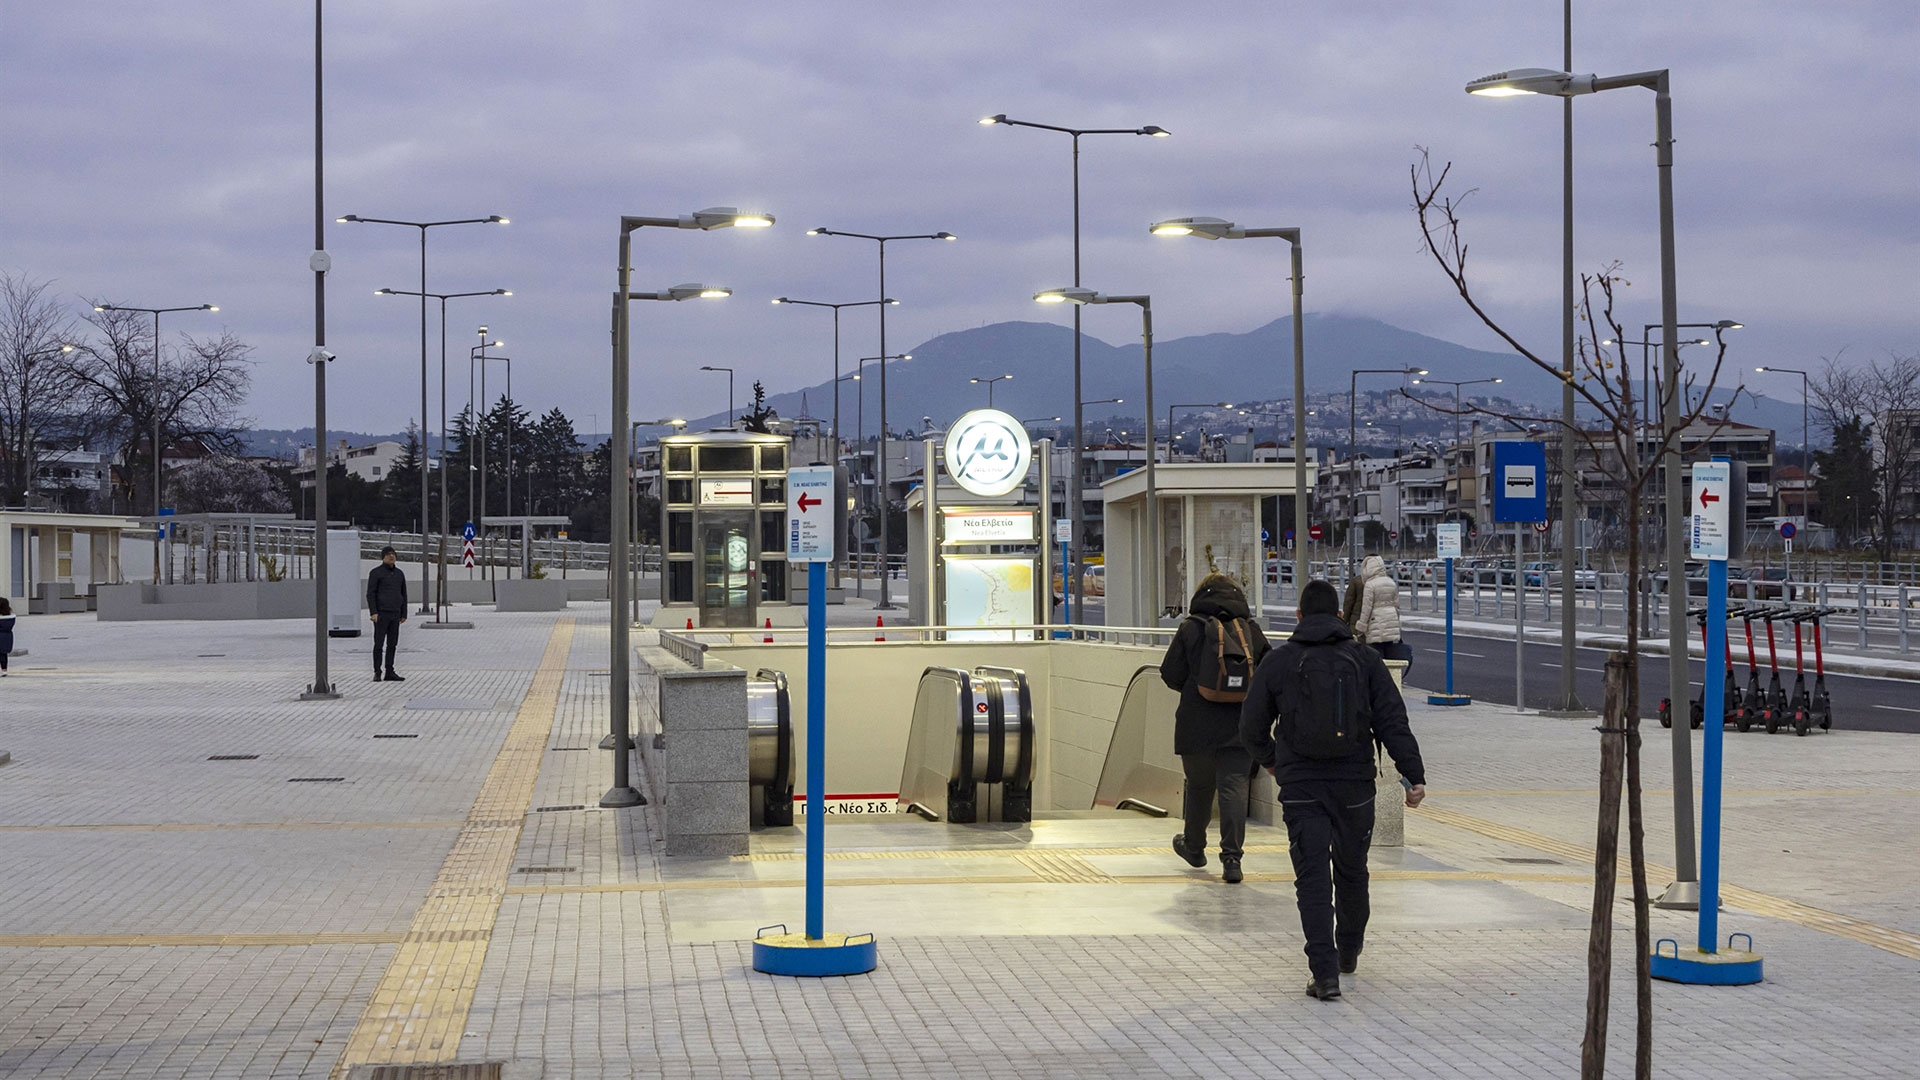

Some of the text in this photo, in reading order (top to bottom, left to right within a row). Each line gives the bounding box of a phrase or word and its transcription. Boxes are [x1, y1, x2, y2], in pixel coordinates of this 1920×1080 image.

[963, 518, 1013, 528] Νέα Ελβετία
[839, 802, 863, 814] Νέο
[867, 801, 891, 814] Σιδ.
